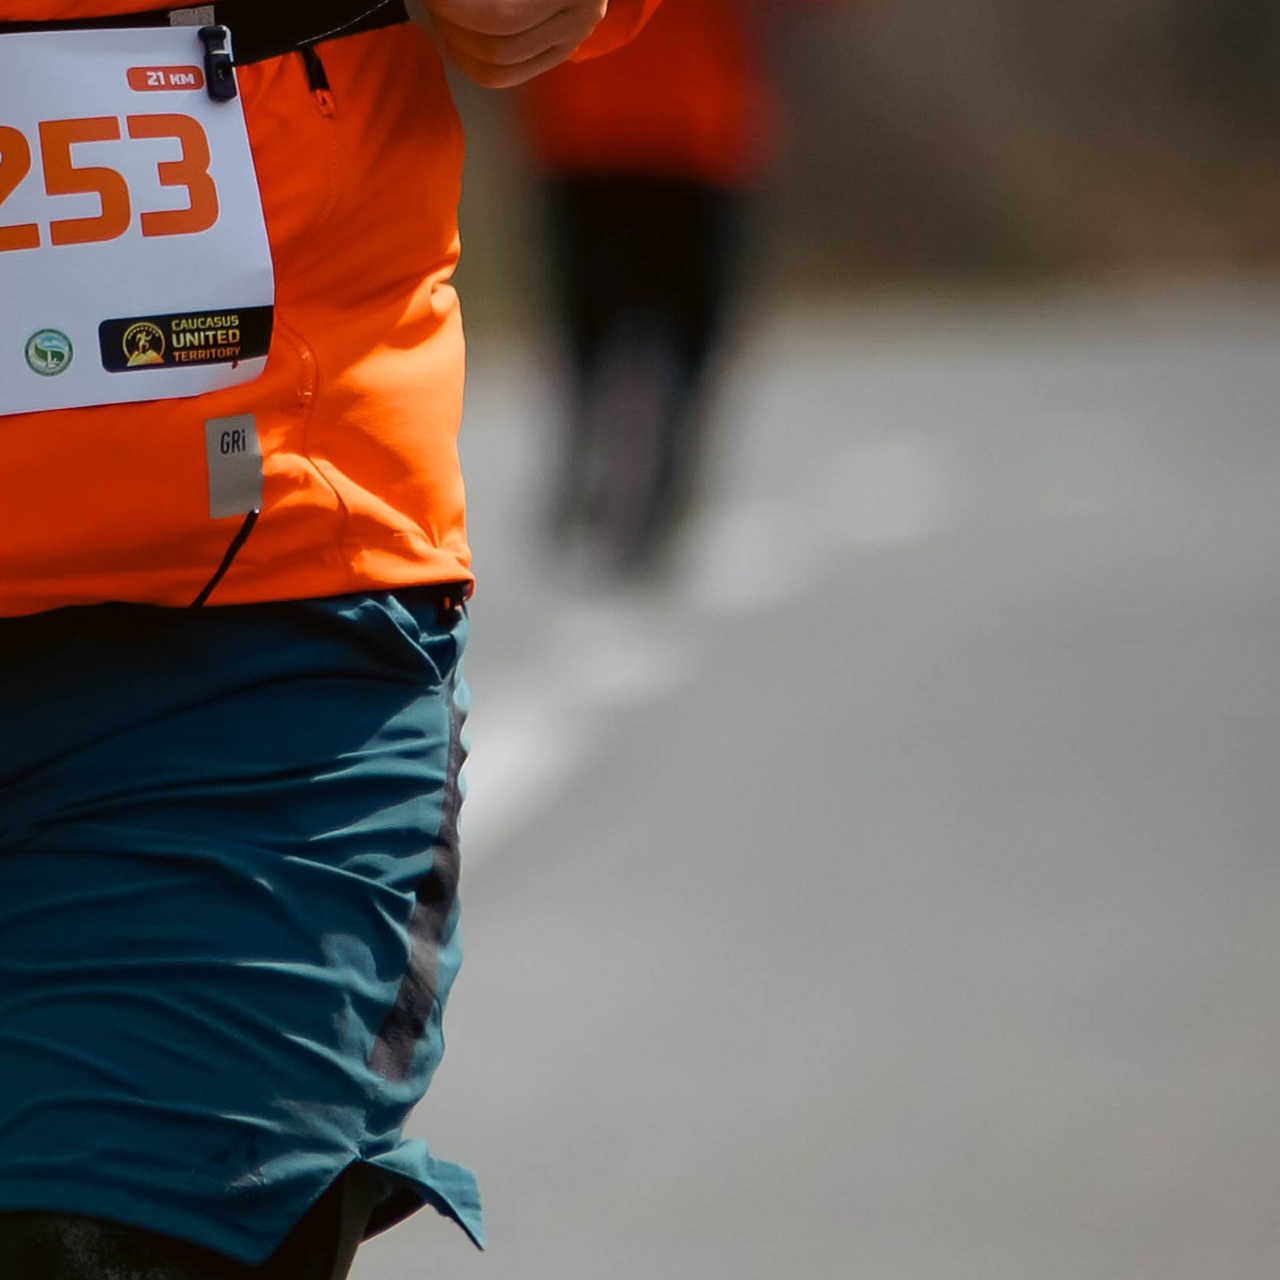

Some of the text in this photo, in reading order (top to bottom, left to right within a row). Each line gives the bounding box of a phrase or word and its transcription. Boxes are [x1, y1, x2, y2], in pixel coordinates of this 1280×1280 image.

[146, 71, 166, 86] 21
[171, 315, 240, 332] CAUCASUS
[172, 329, 241, 349] UNITED
[173, 347, 241, 363] TERRITORY
[220, 429, 246, 455] GRi
